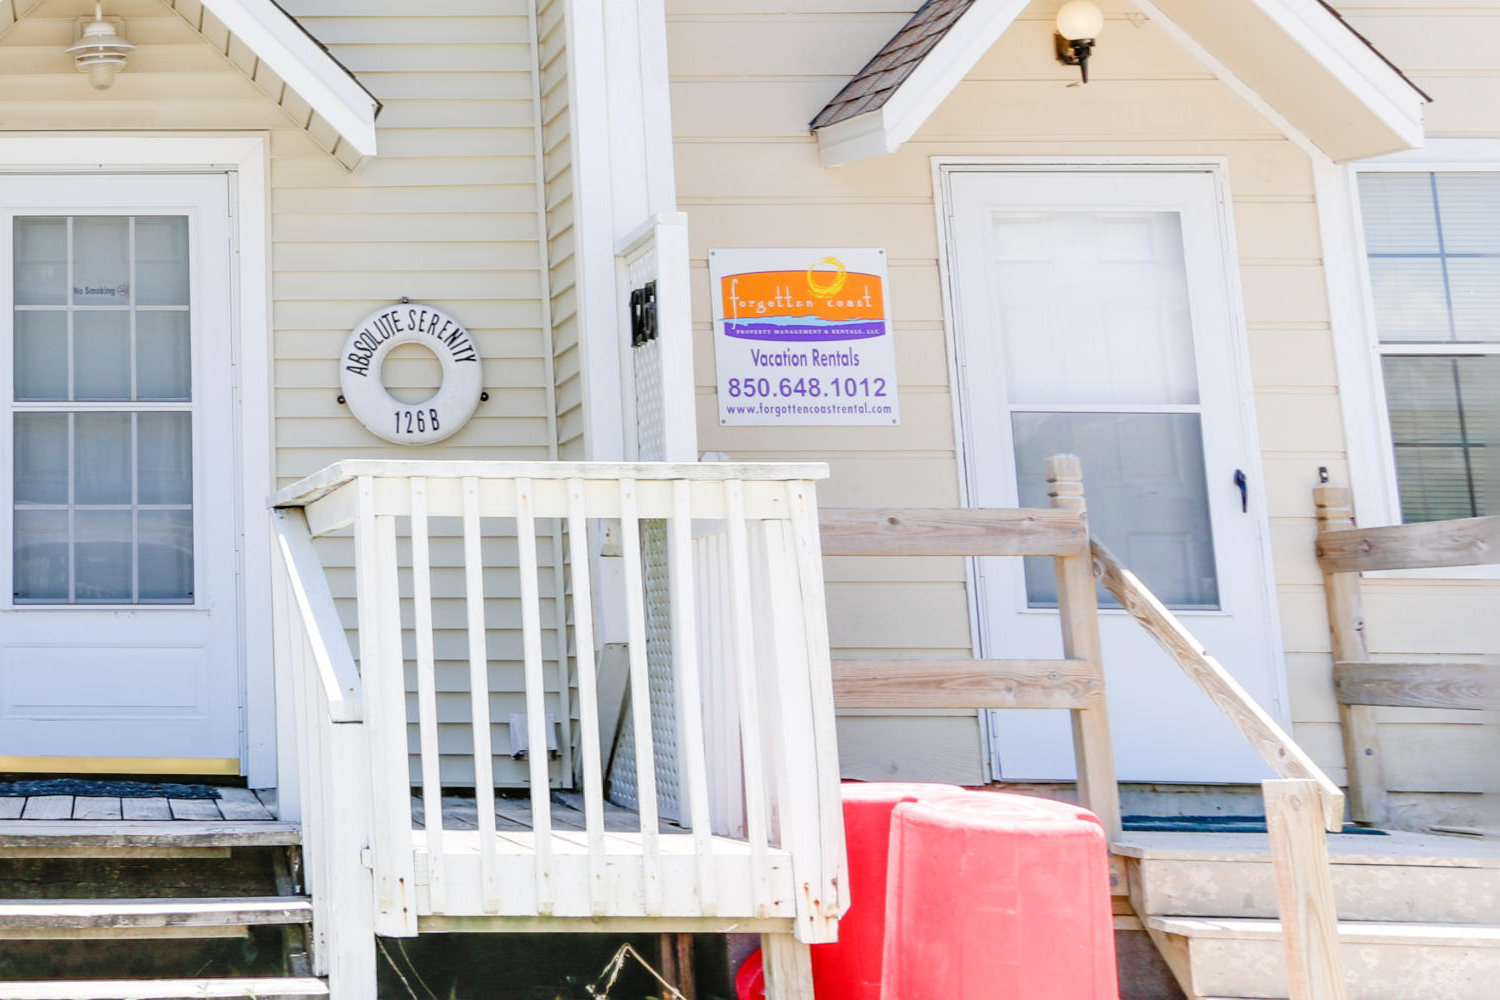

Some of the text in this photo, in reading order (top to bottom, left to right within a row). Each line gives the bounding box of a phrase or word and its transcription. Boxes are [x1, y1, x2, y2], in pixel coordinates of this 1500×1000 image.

[85, 285, 116, 297] Smoking
[729, 278, 873, 330] forgotten coast
[346, 309, 477, 377] ABSOLUTE SERENITY
[750, 346, 860, 367] Vacation Rentals
[728, 377, 887, 398] 850.648.1012
[726, 402, 892, 418] www.forgottencoastrental.com
